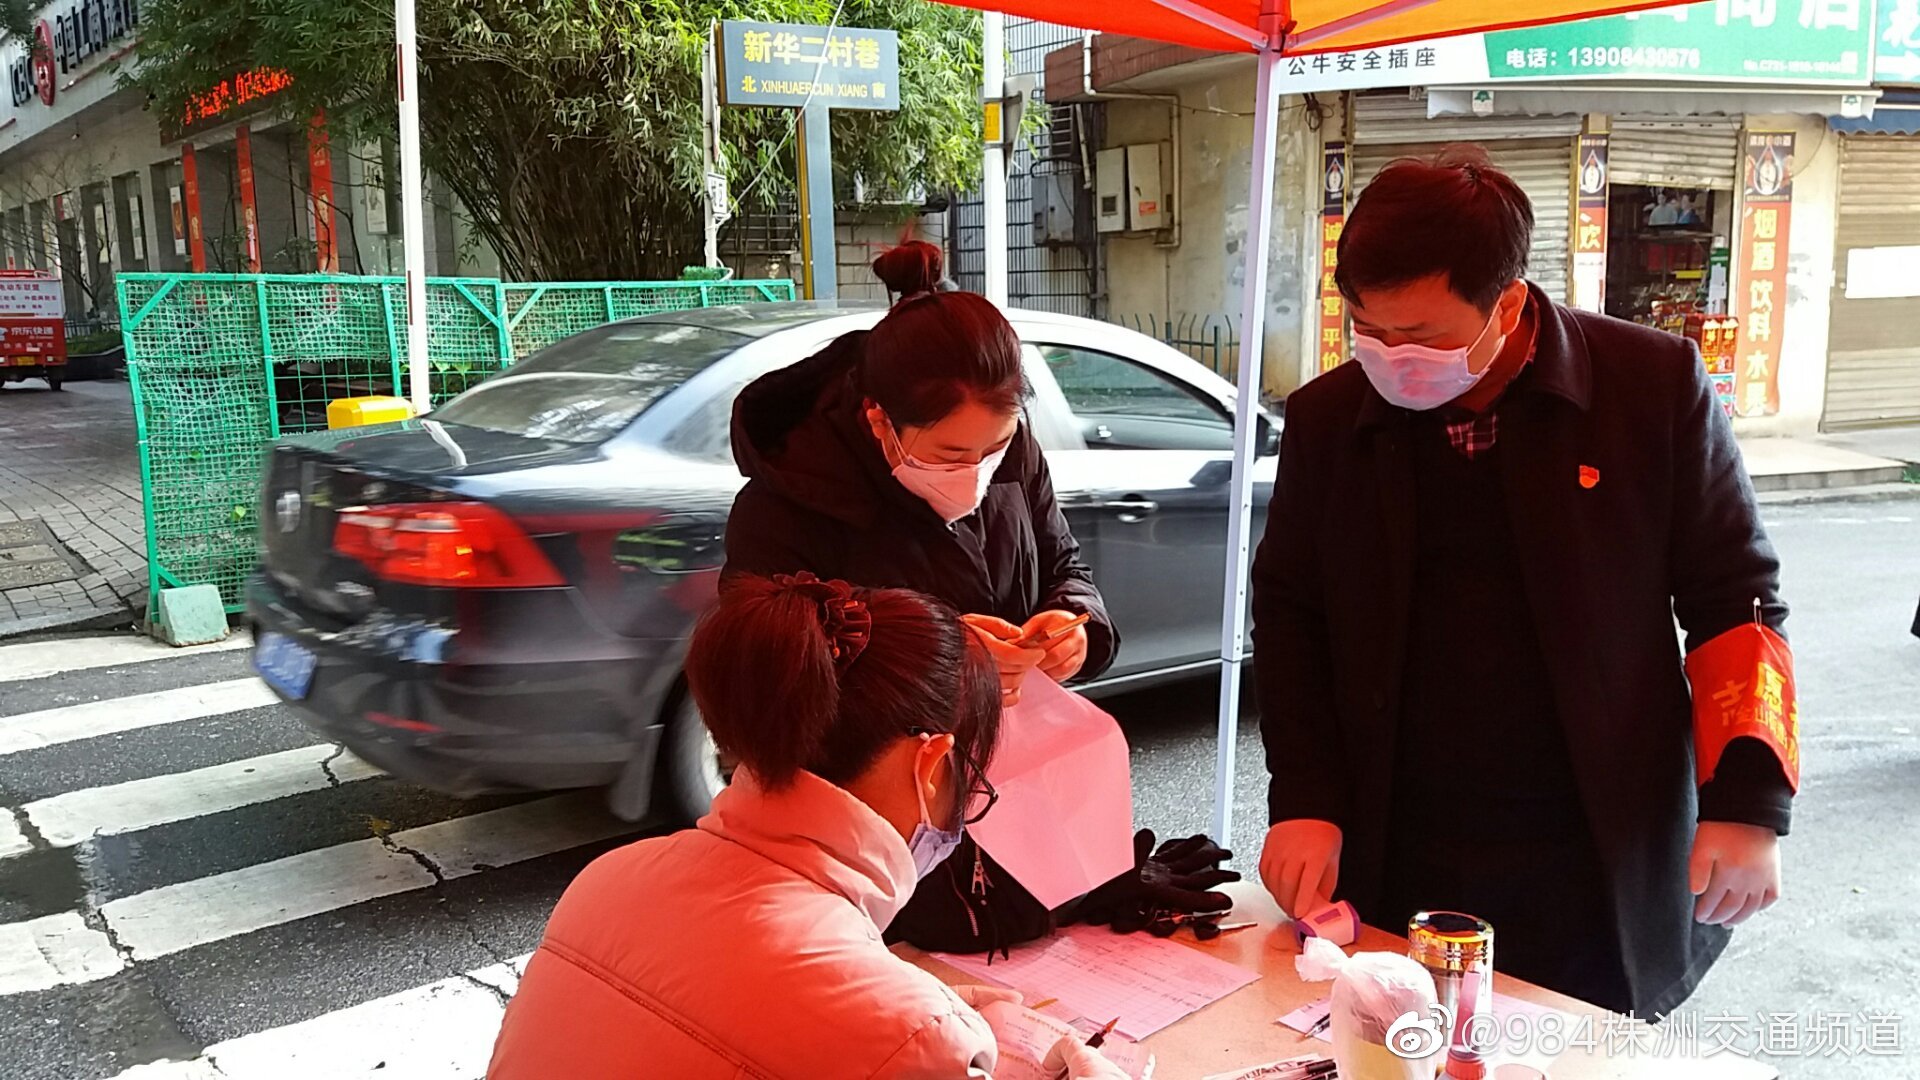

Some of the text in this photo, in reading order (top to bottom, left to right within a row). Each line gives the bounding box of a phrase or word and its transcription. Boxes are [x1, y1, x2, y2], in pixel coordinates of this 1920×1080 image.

[744, 30, 880, 69] 新华二村巷
[1288, 47, 1436, 76] 公牛安全插座
[742, 76, 886, 98] 北 XINHUAERCUN XIANG 南
